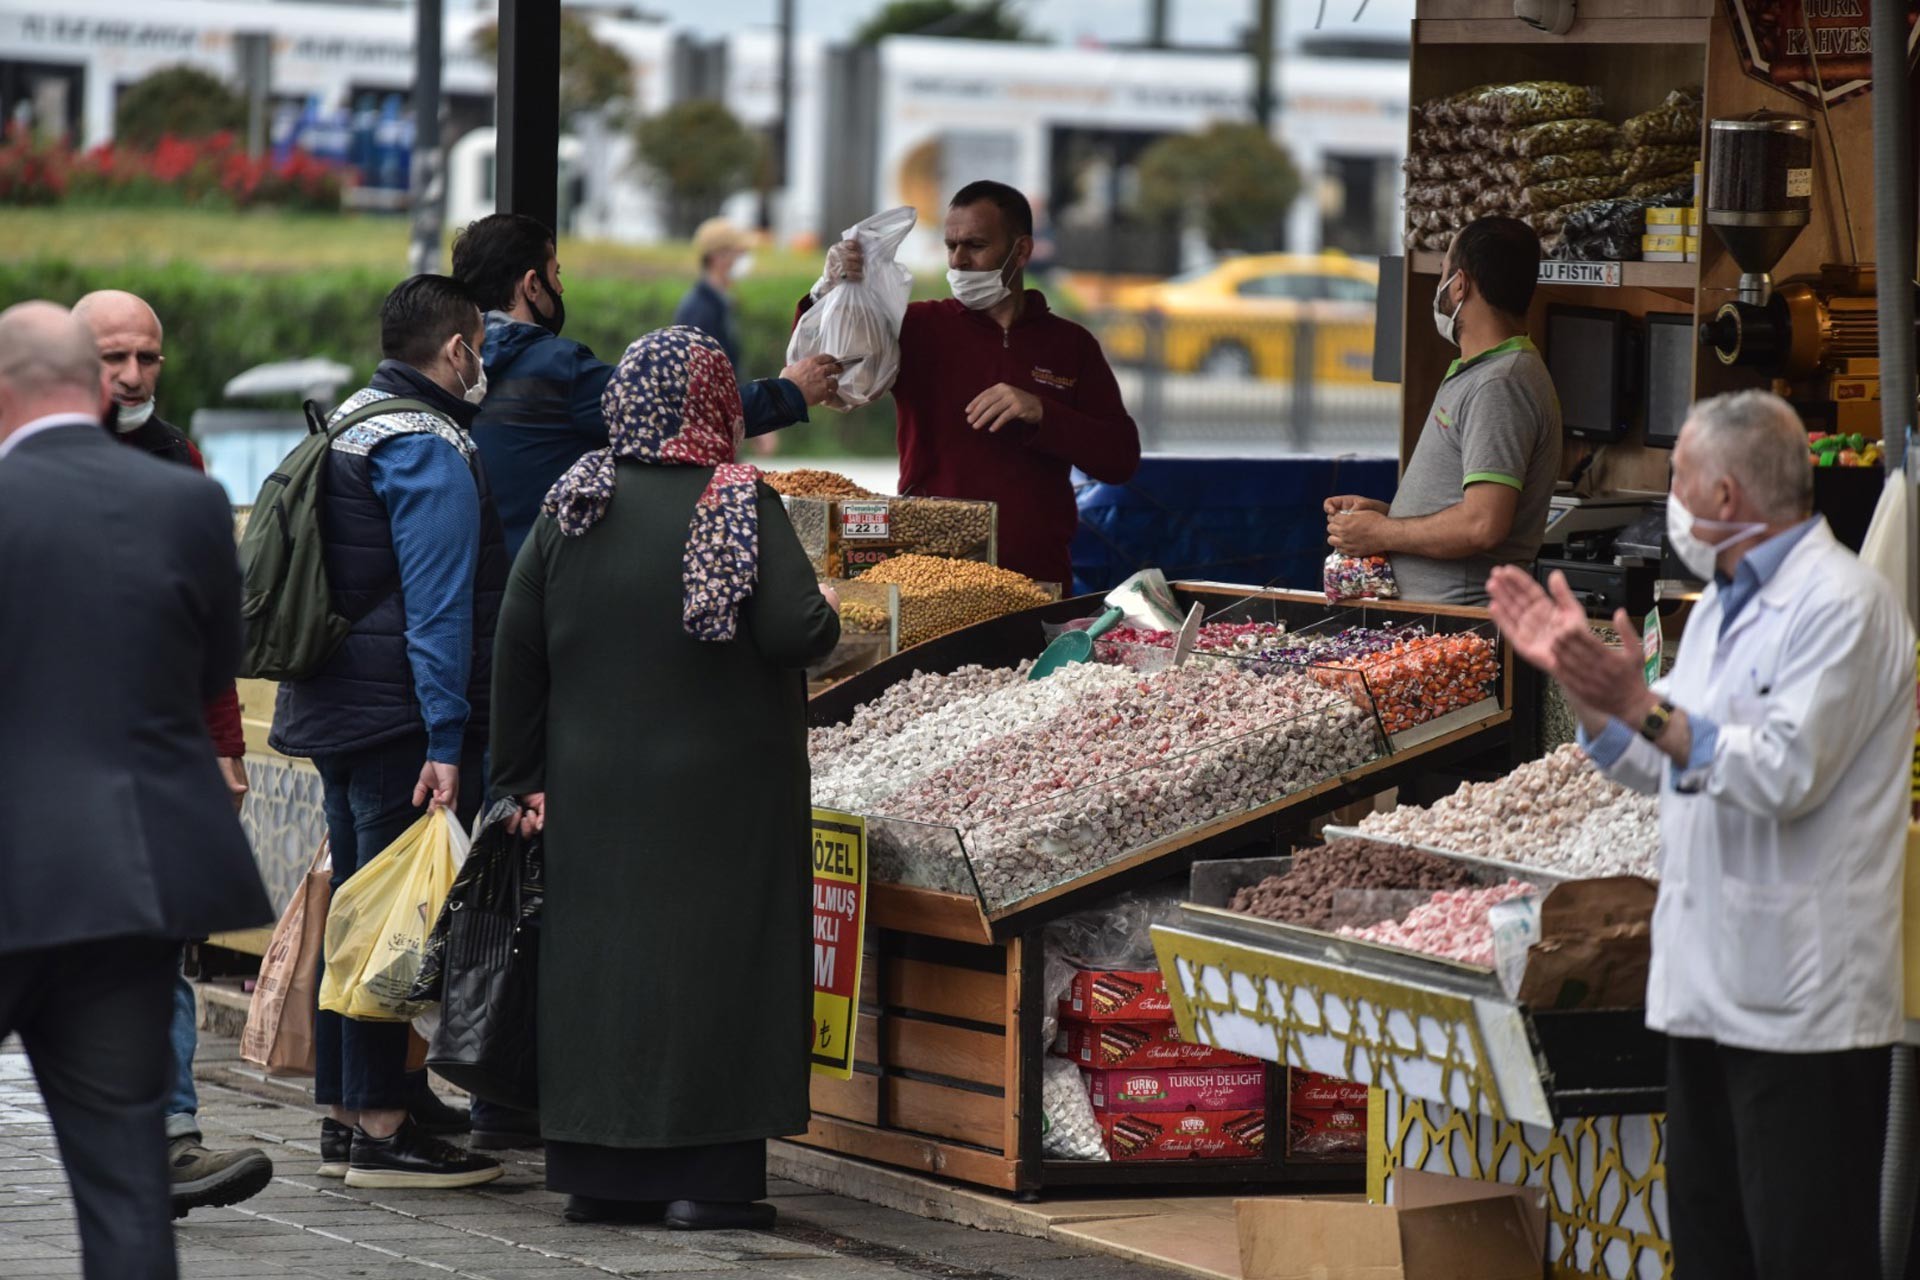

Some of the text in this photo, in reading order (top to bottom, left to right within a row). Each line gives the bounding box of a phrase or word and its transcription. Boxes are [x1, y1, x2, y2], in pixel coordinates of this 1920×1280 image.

[1786, 27, 1872, 55] KAHVES
[1559, 264, 1602, 280] FISTIK
[855, 524, 870, 533] 22
[814, 832, 854, 876] ÖZEL
[1147, 1045, 1213, 1061] Turkish Delight
[1126, 1079, 1159, 1090] TURKO
[1168, 1074, 1262, 1088] TURKISH DELIGHT
[1160, 1138, 1225, 1153] Turkish Delight
